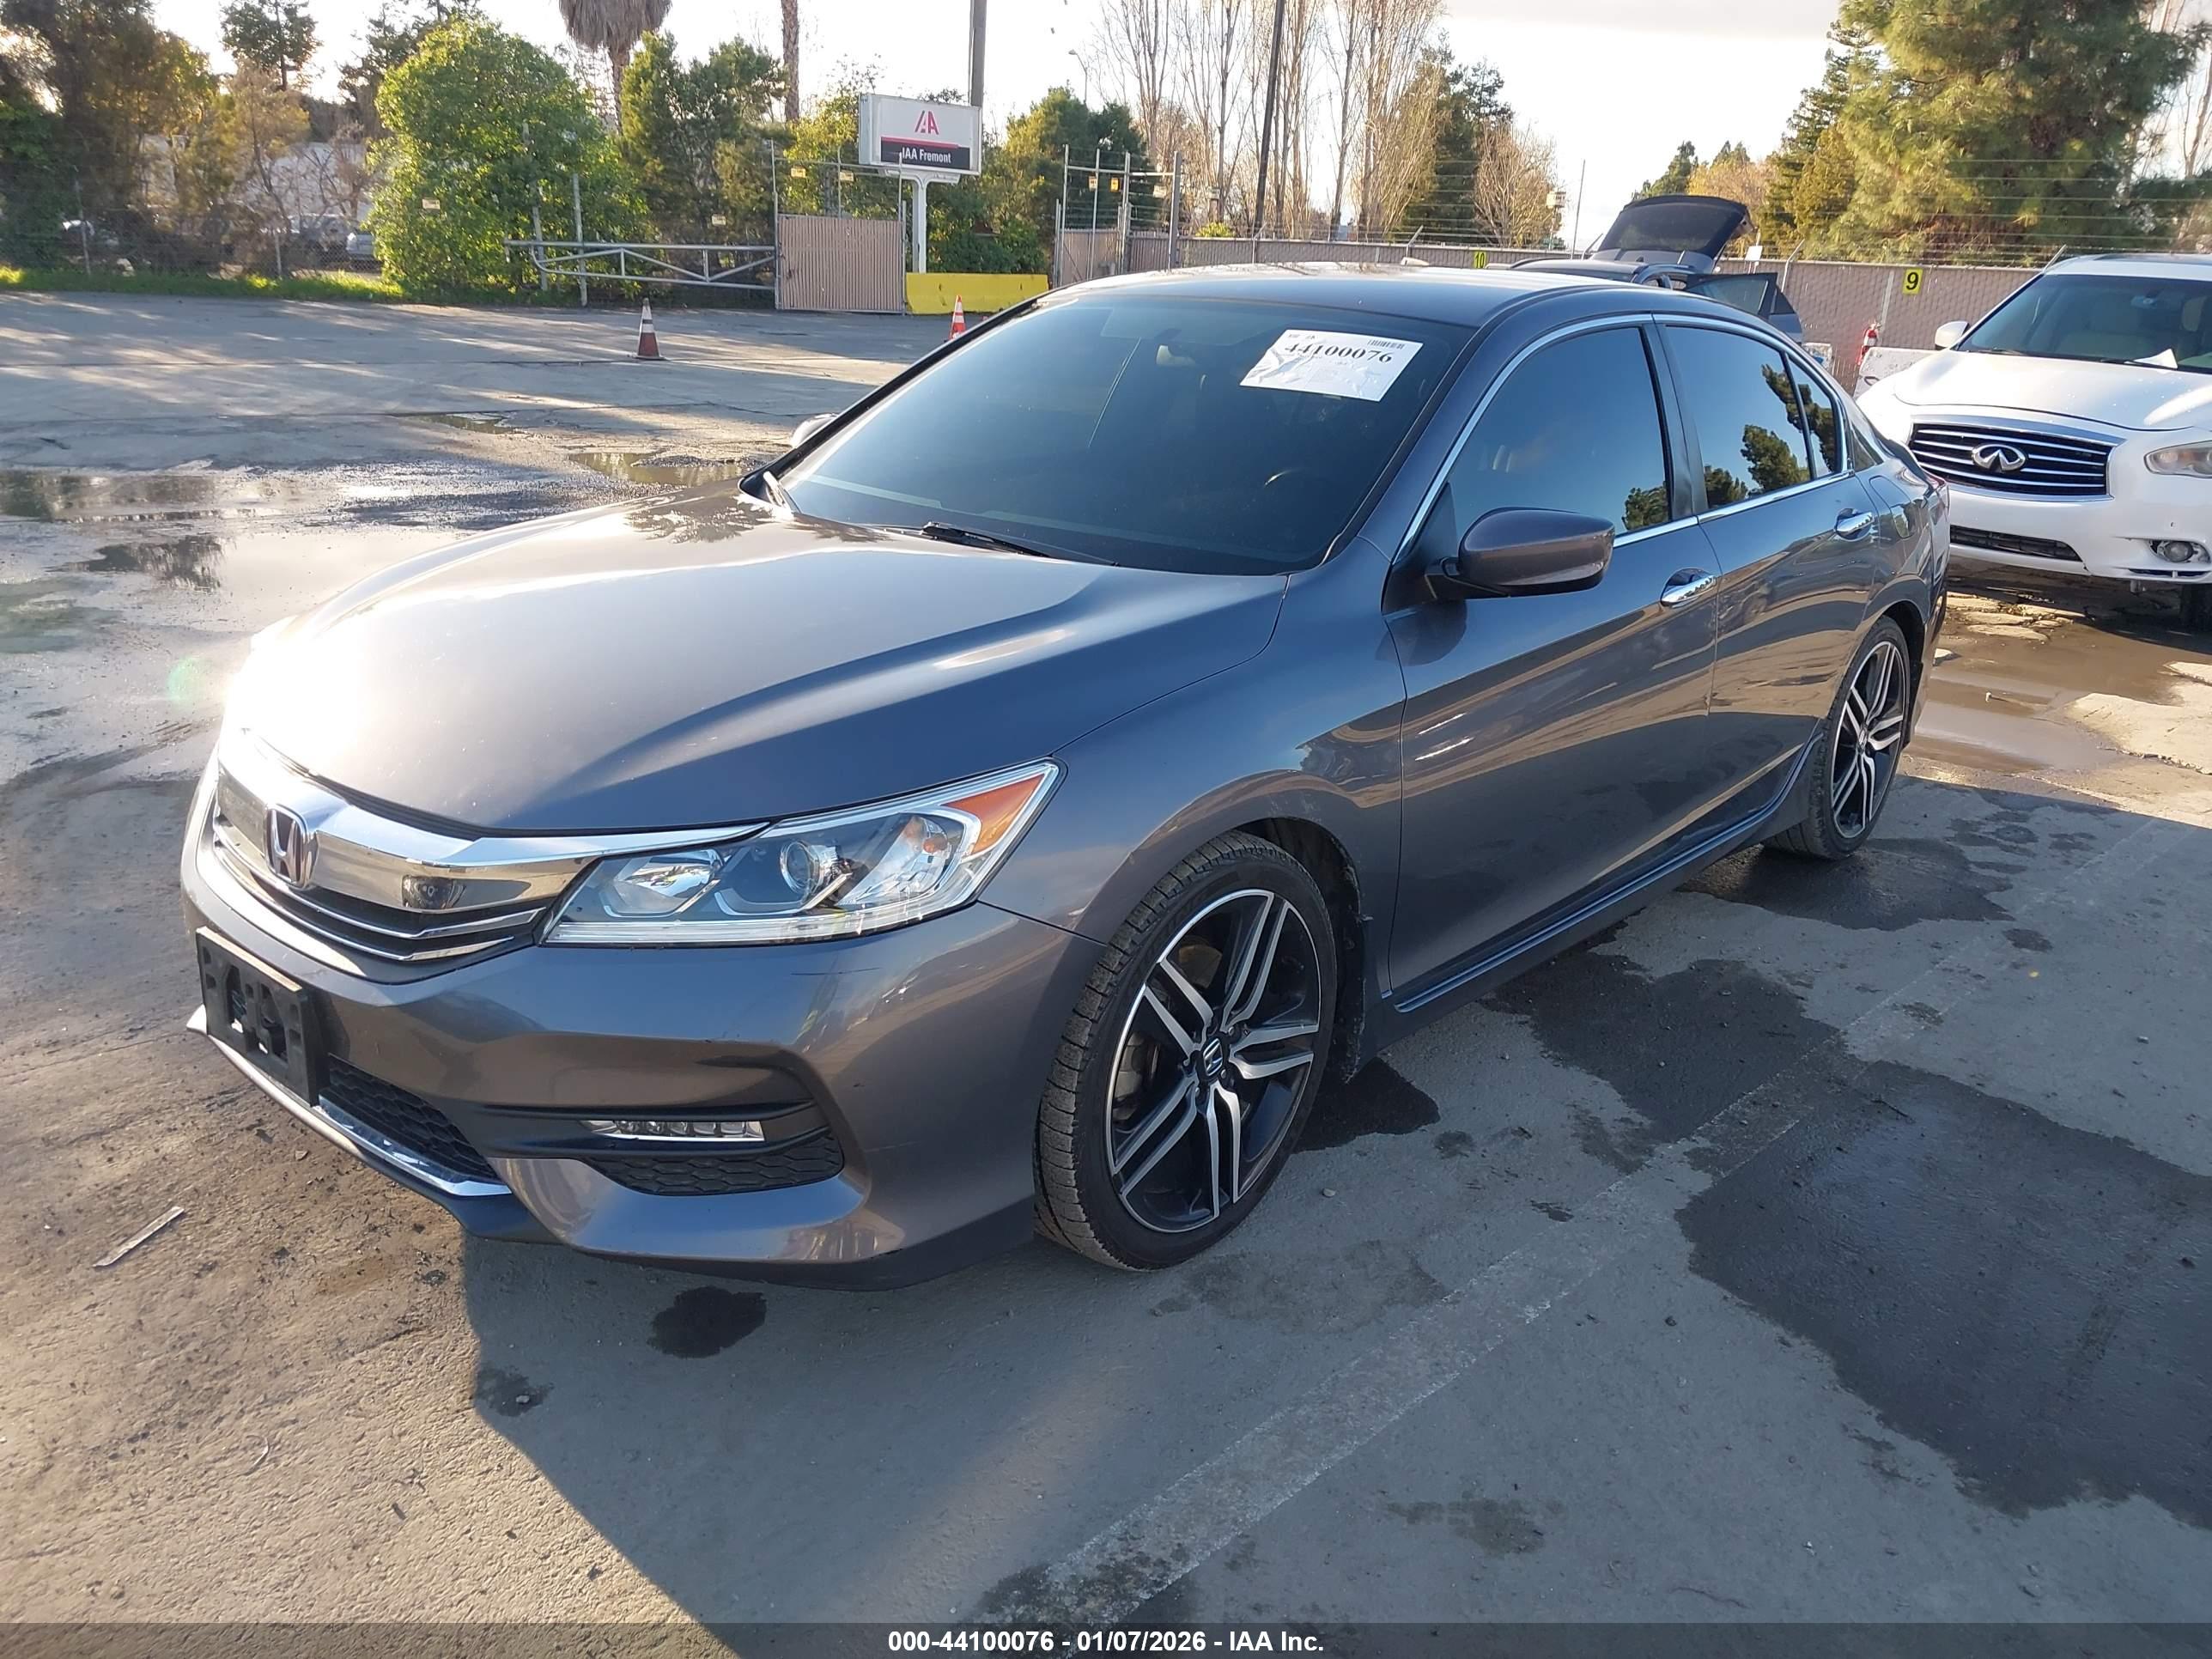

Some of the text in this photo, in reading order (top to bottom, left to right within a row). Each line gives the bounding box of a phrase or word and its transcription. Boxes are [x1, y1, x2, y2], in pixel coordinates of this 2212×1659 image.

[902, 147, 951, 163] IAA Fremont
[1475, 252, 1485, 269] 10
[1905, 271, 1919, 290] 9
[1285, 343, 1393, 363] 44100076
